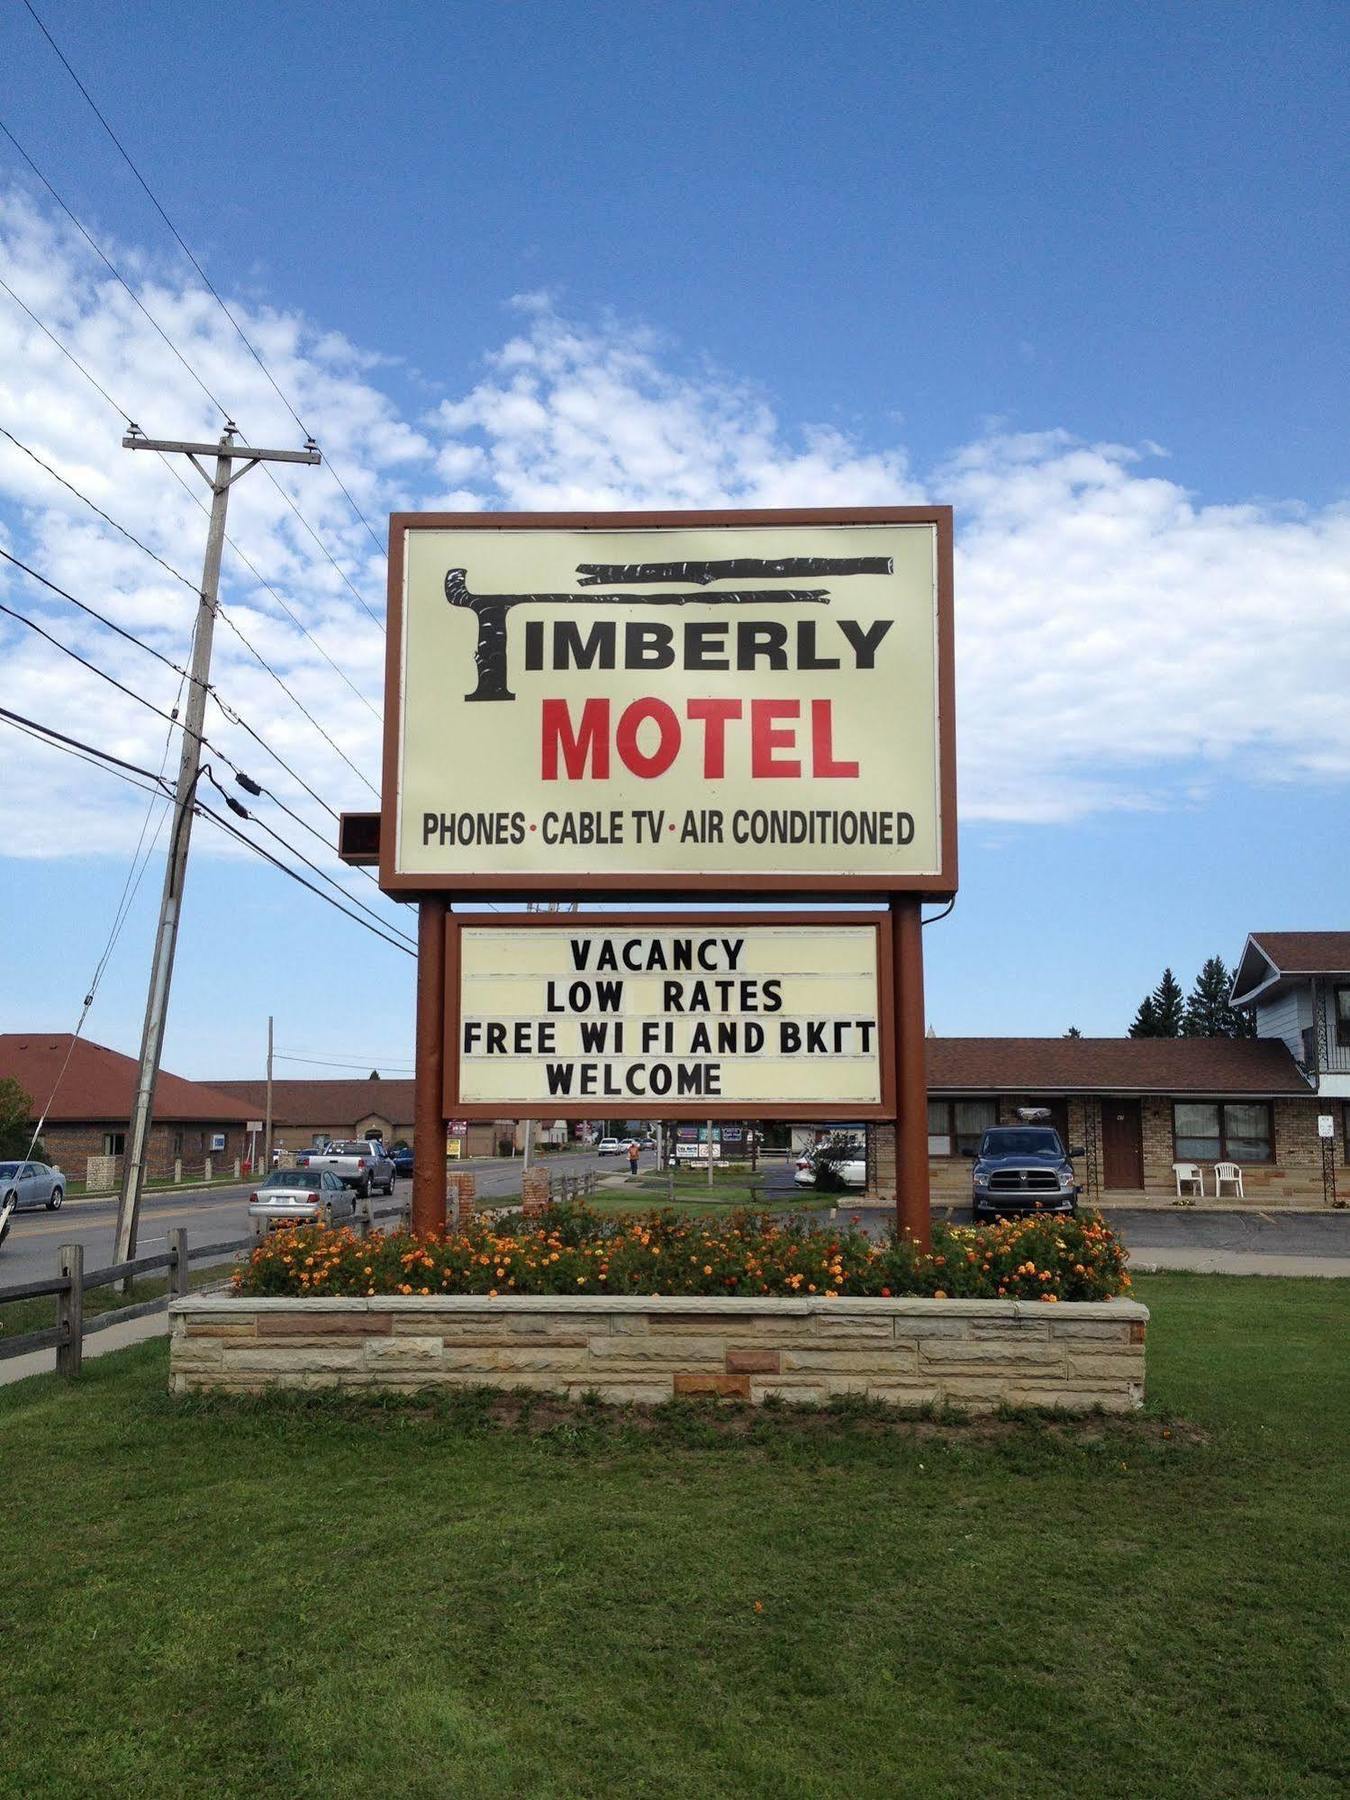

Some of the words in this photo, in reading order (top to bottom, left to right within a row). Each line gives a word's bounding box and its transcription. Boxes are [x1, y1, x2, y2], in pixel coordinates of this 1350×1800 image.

[445, 569, 894, 702] TIMBERLY
[542, 698, 858, 780] MOTEL
[424, 813, 525, 845] PHONES
[543, 812, 623, 844] CABLE
[632, 811, 664, 843] TV
[681, 811, 723, 843] AIR
[733, 810, 914, 844] CONDITIONED
[571, 939, 744, 970] VACANCY
[548, 981, 623, 1012] LOW
[664, 980, 782, 1012] RATES
[464, 1022, 555, 1053] FREE
[690, 1022, 764, 1053] AND
[546, 1064, 721, 1095] WELCOME
